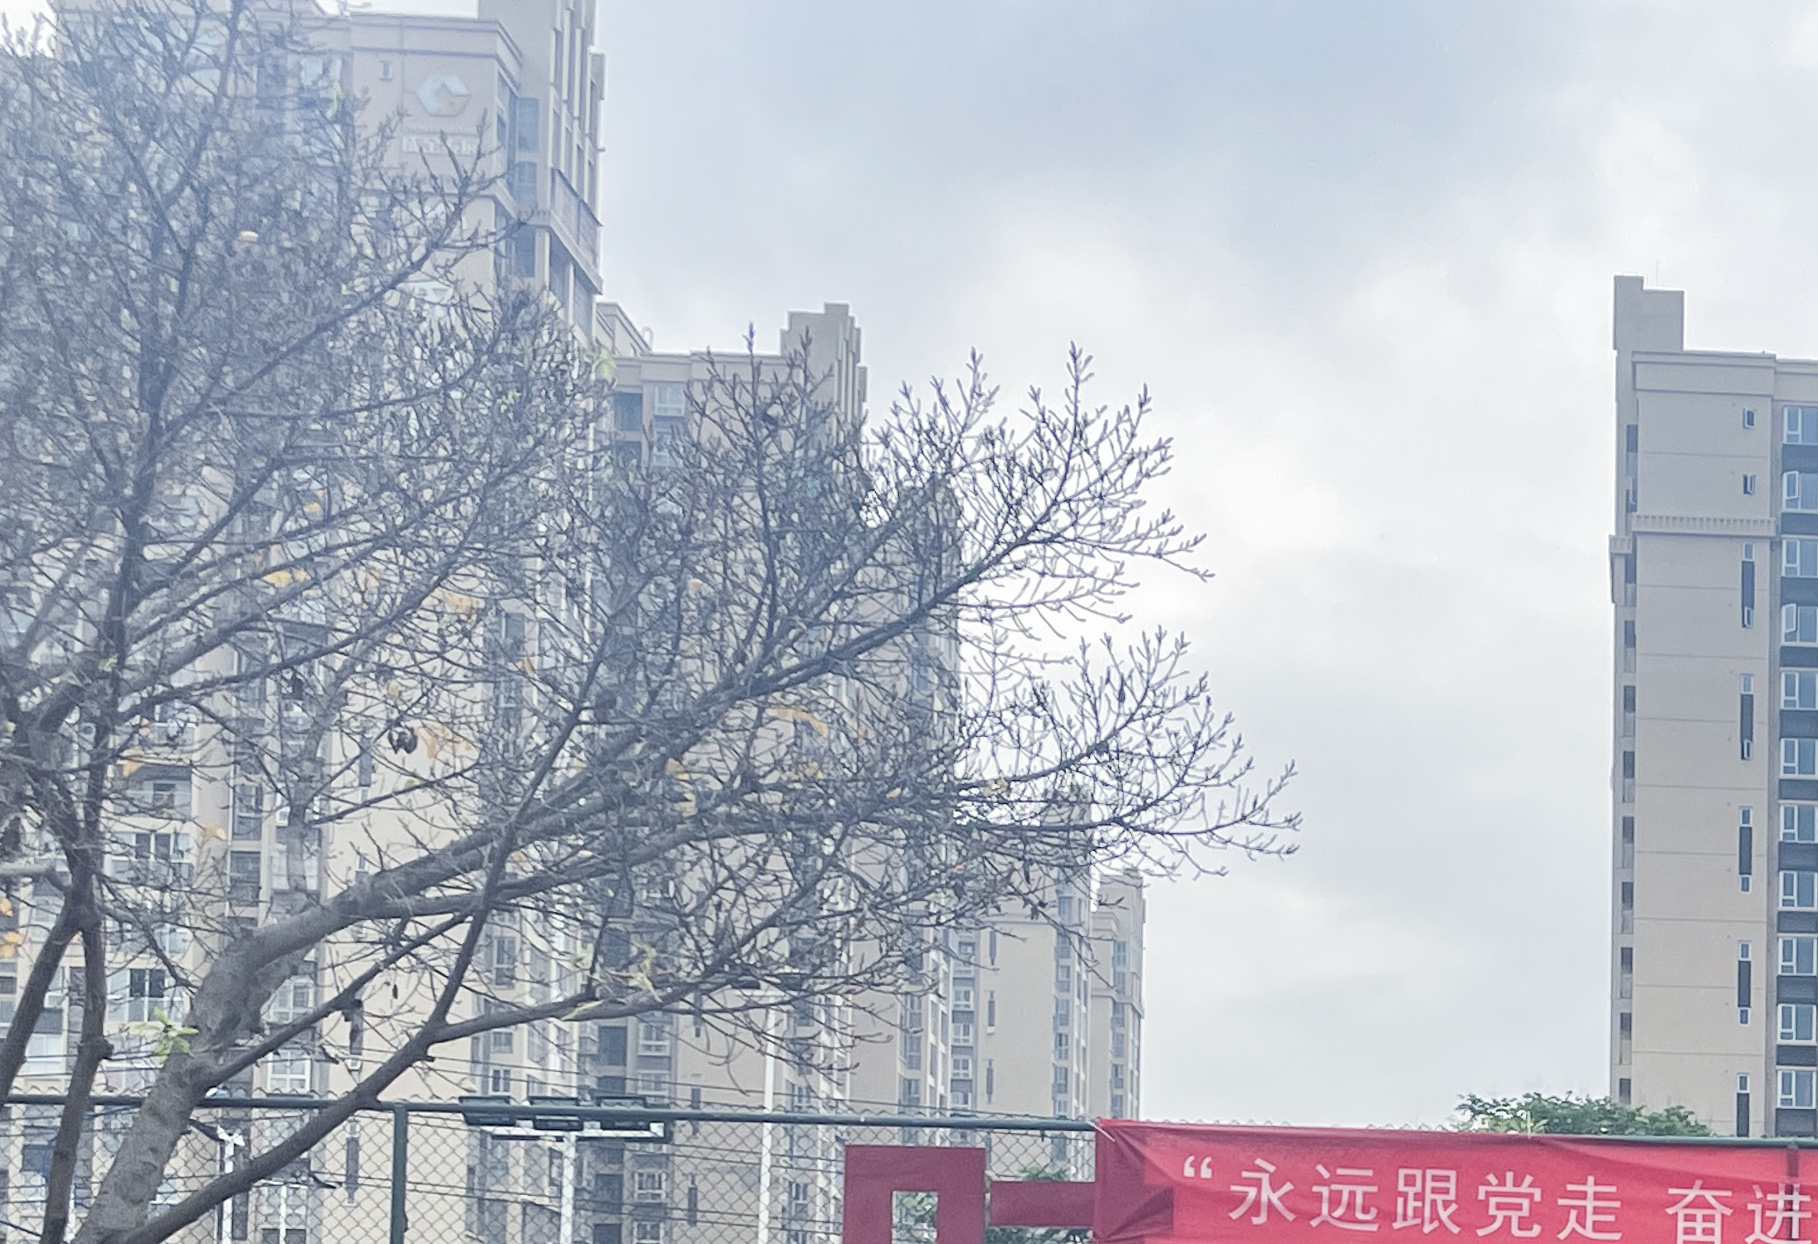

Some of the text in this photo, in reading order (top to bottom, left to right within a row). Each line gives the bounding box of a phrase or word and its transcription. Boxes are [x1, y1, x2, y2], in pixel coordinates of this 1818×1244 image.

[1183, 1155, 1622, 1241] “永远跟党走
